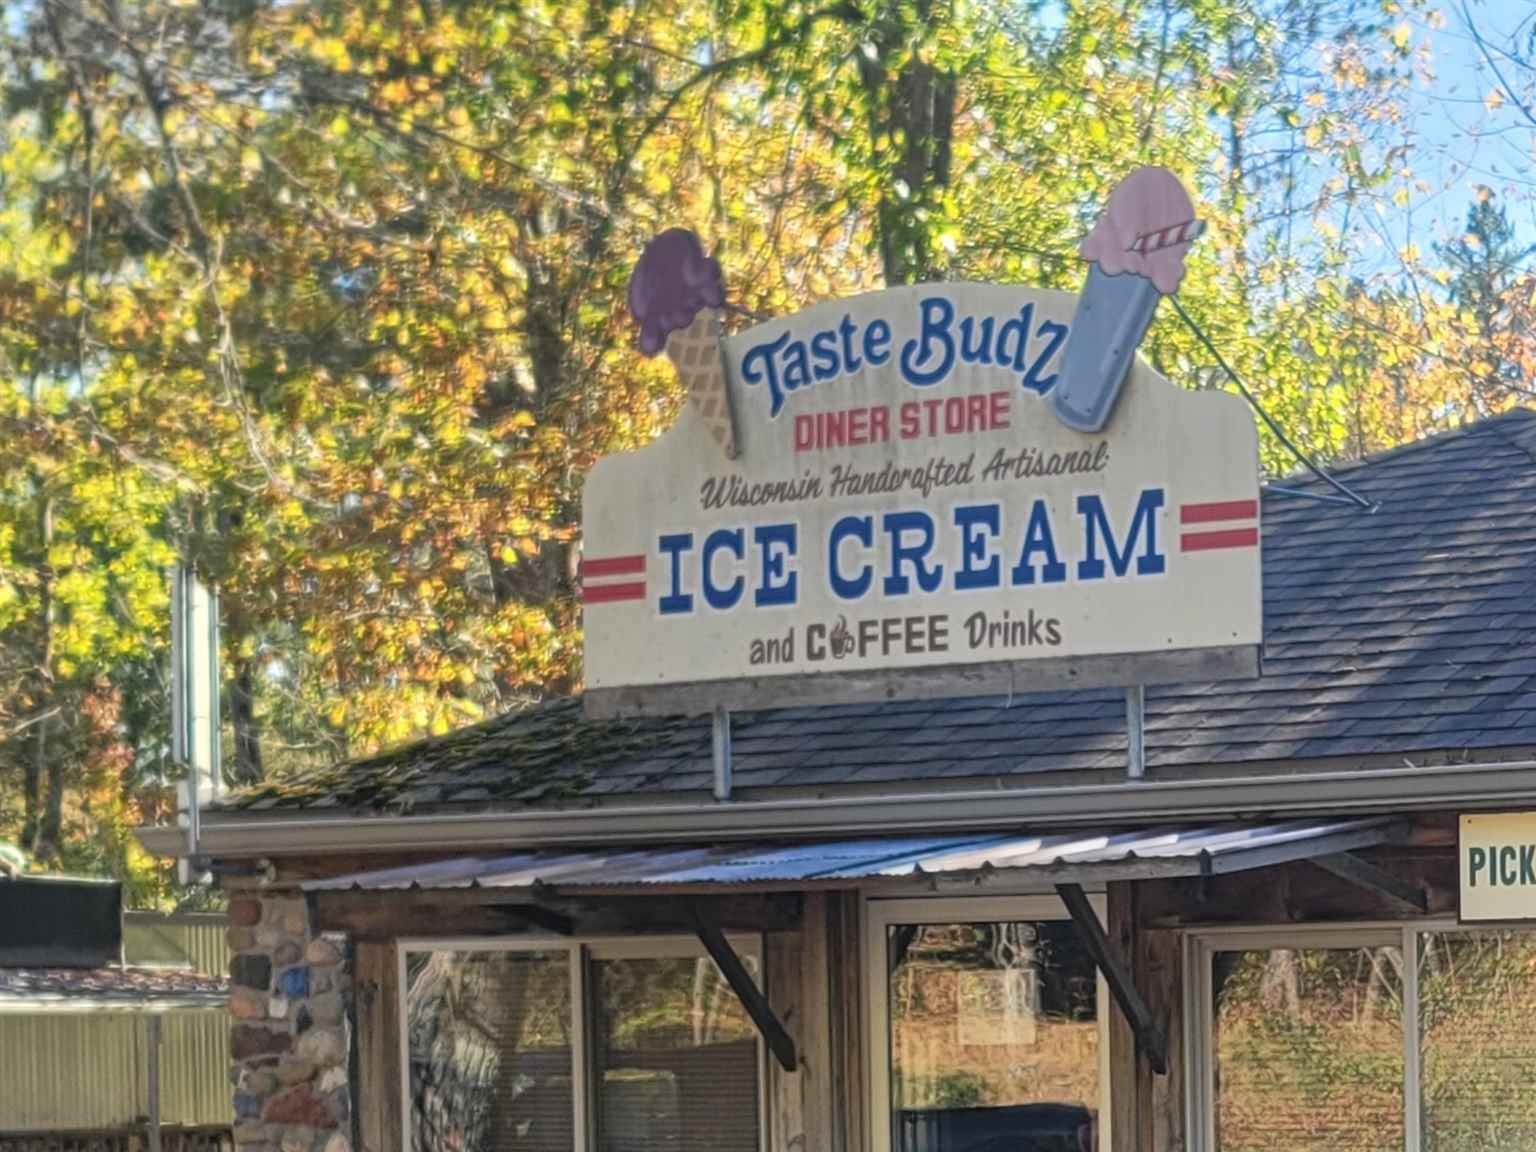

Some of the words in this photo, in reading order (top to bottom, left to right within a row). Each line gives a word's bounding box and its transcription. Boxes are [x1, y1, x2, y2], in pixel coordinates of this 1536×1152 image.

[741, 314, 892, 418] Taste
[901, 297, 1068, 396] Budz
[793, 405, 891, 453] DINER
[901, 391, 1011, 440] STORE
[700, 472, 823, 509] Wisconsin
[829, 453, 975, 497] Handcrafted
[982, 442, 1108, 480] Artisanal
[659, 523, 798, 615] ICE
[829, 488, 1165, 600] CREAM
[749, 628, 794, 665] and
[964, 609, 1063, 649] Drinks
[1469, 844, 1536, 887] PICK
